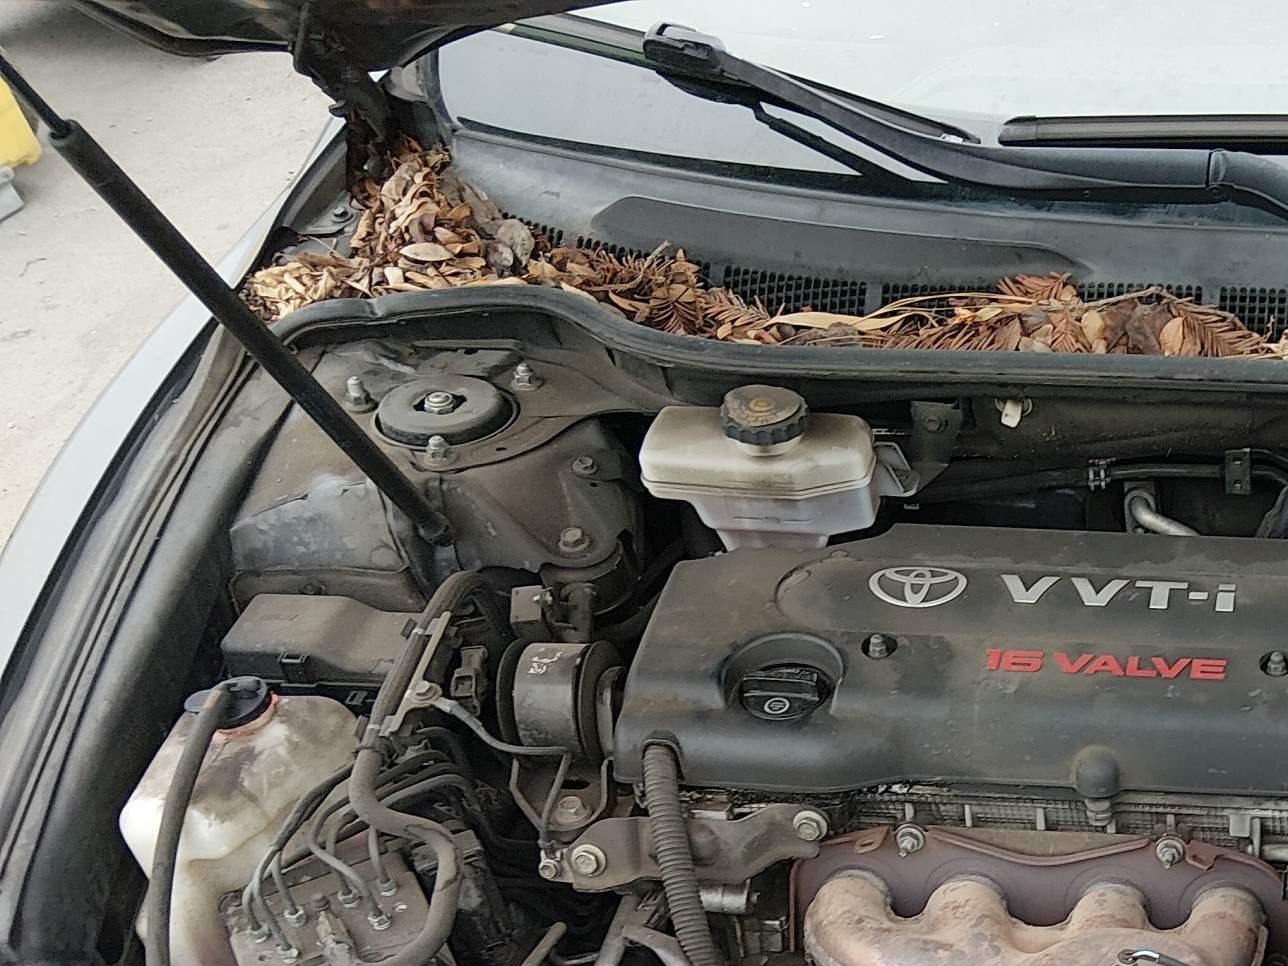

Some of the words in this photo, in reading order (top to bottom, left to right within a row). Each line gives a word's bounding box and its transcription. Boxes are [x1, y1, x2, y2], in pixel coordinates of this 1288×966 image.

[1001, 574, 1236, 612] VVT-i
[986, 648, 1045, 673] 16
[1054, 651, 1227, 680] VALVE
